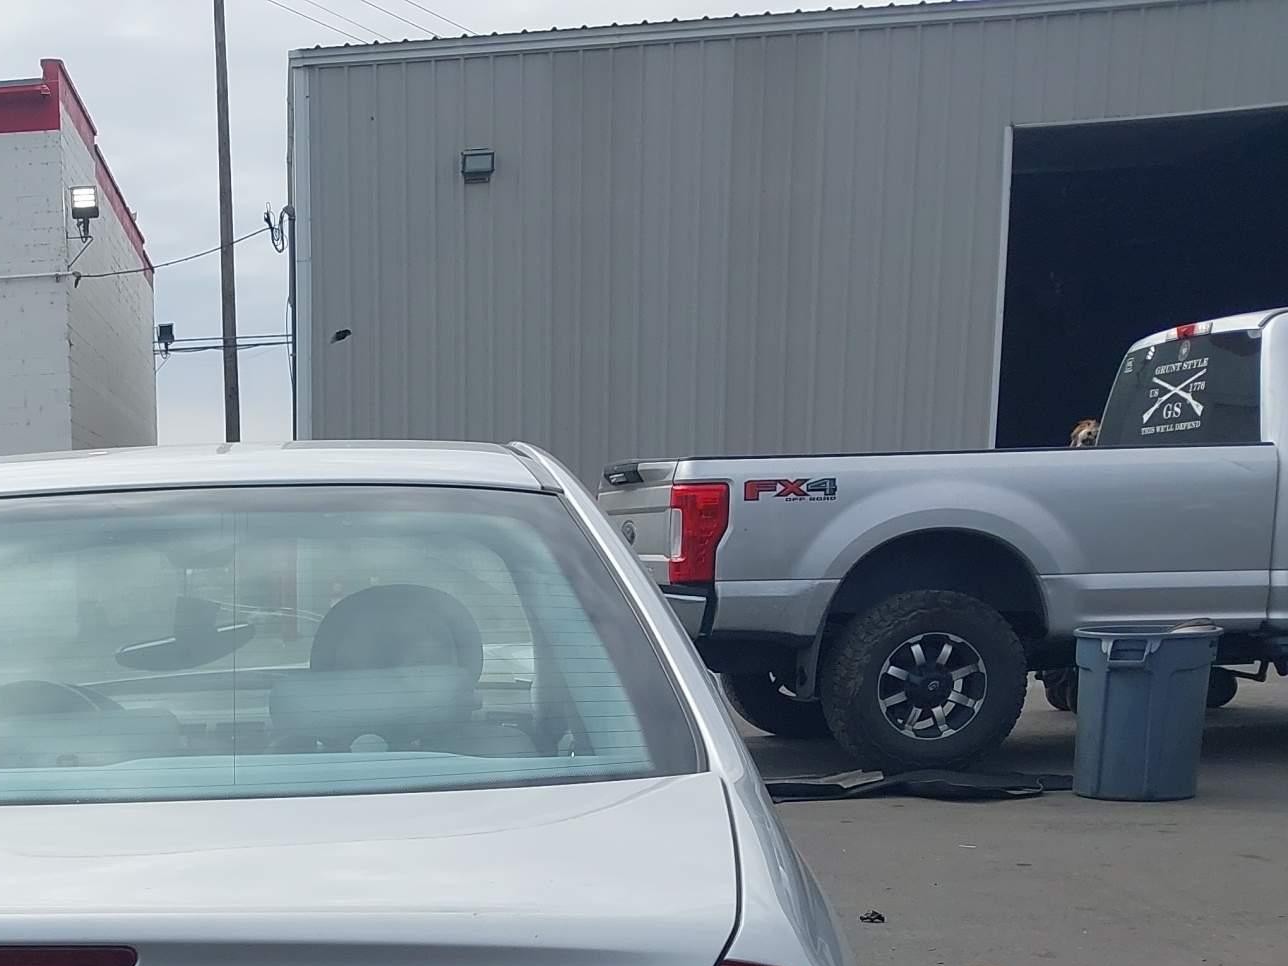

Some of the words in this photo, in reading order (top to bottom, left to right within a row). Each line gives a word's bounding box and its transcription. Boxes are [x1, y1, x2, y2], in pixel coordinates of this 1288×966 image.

[1155, 362, 1182, 376] GRUNT
[1182, 357, 1209, 370] STYLE
[1189, 381, 1205, 392] 1776
[1163, 402, 1181, 419] GS
[1175, 420, 1201, 431] DEFEND
[744, 478, 837, 501] FX4
